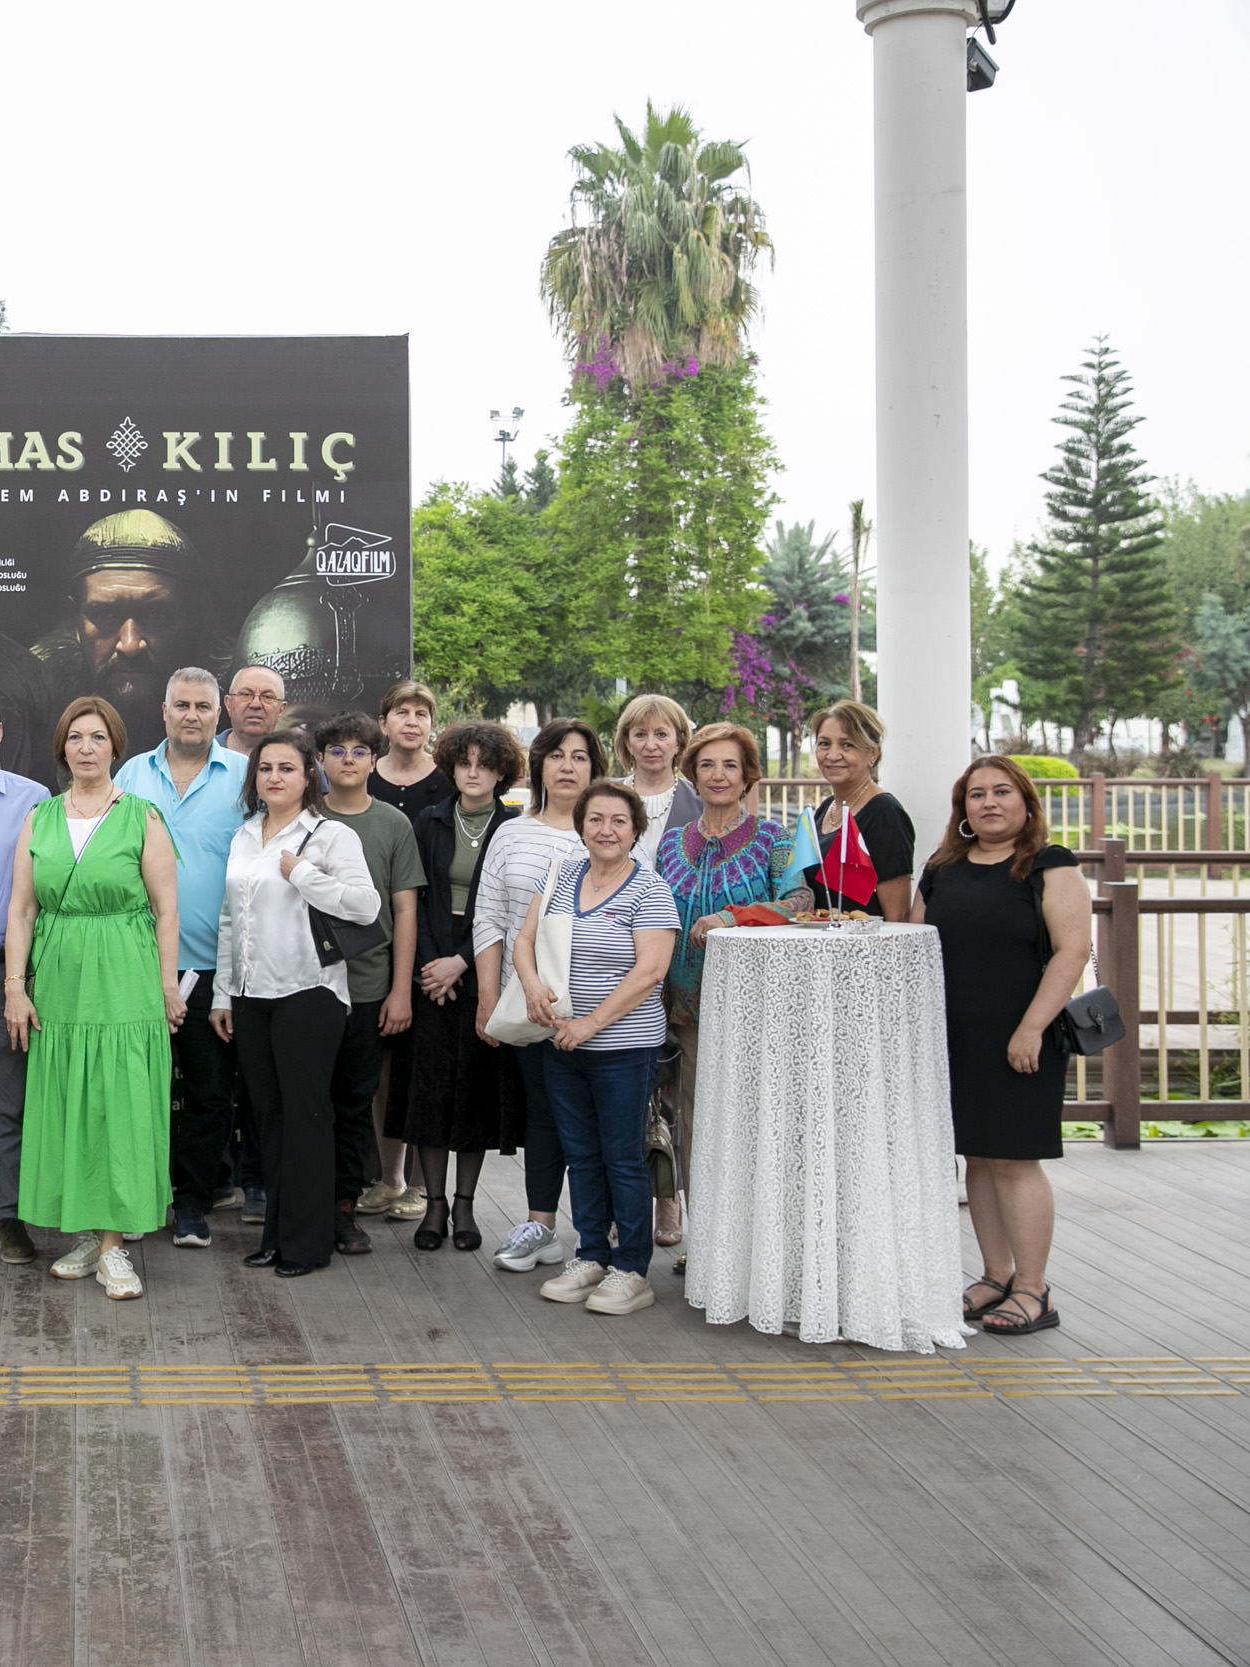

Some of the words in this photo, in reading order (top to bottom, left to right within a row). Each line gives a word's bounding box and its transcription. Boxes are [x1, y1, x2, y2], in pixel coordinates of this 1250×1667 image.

[163, 431, 355, 481] KILIÇ
[58, 489, 239, 506] ABDIRAŞ'IN
[263, 490, 345, 503] FILMI
[316, 551, 390, 573] QAZAQFILM
